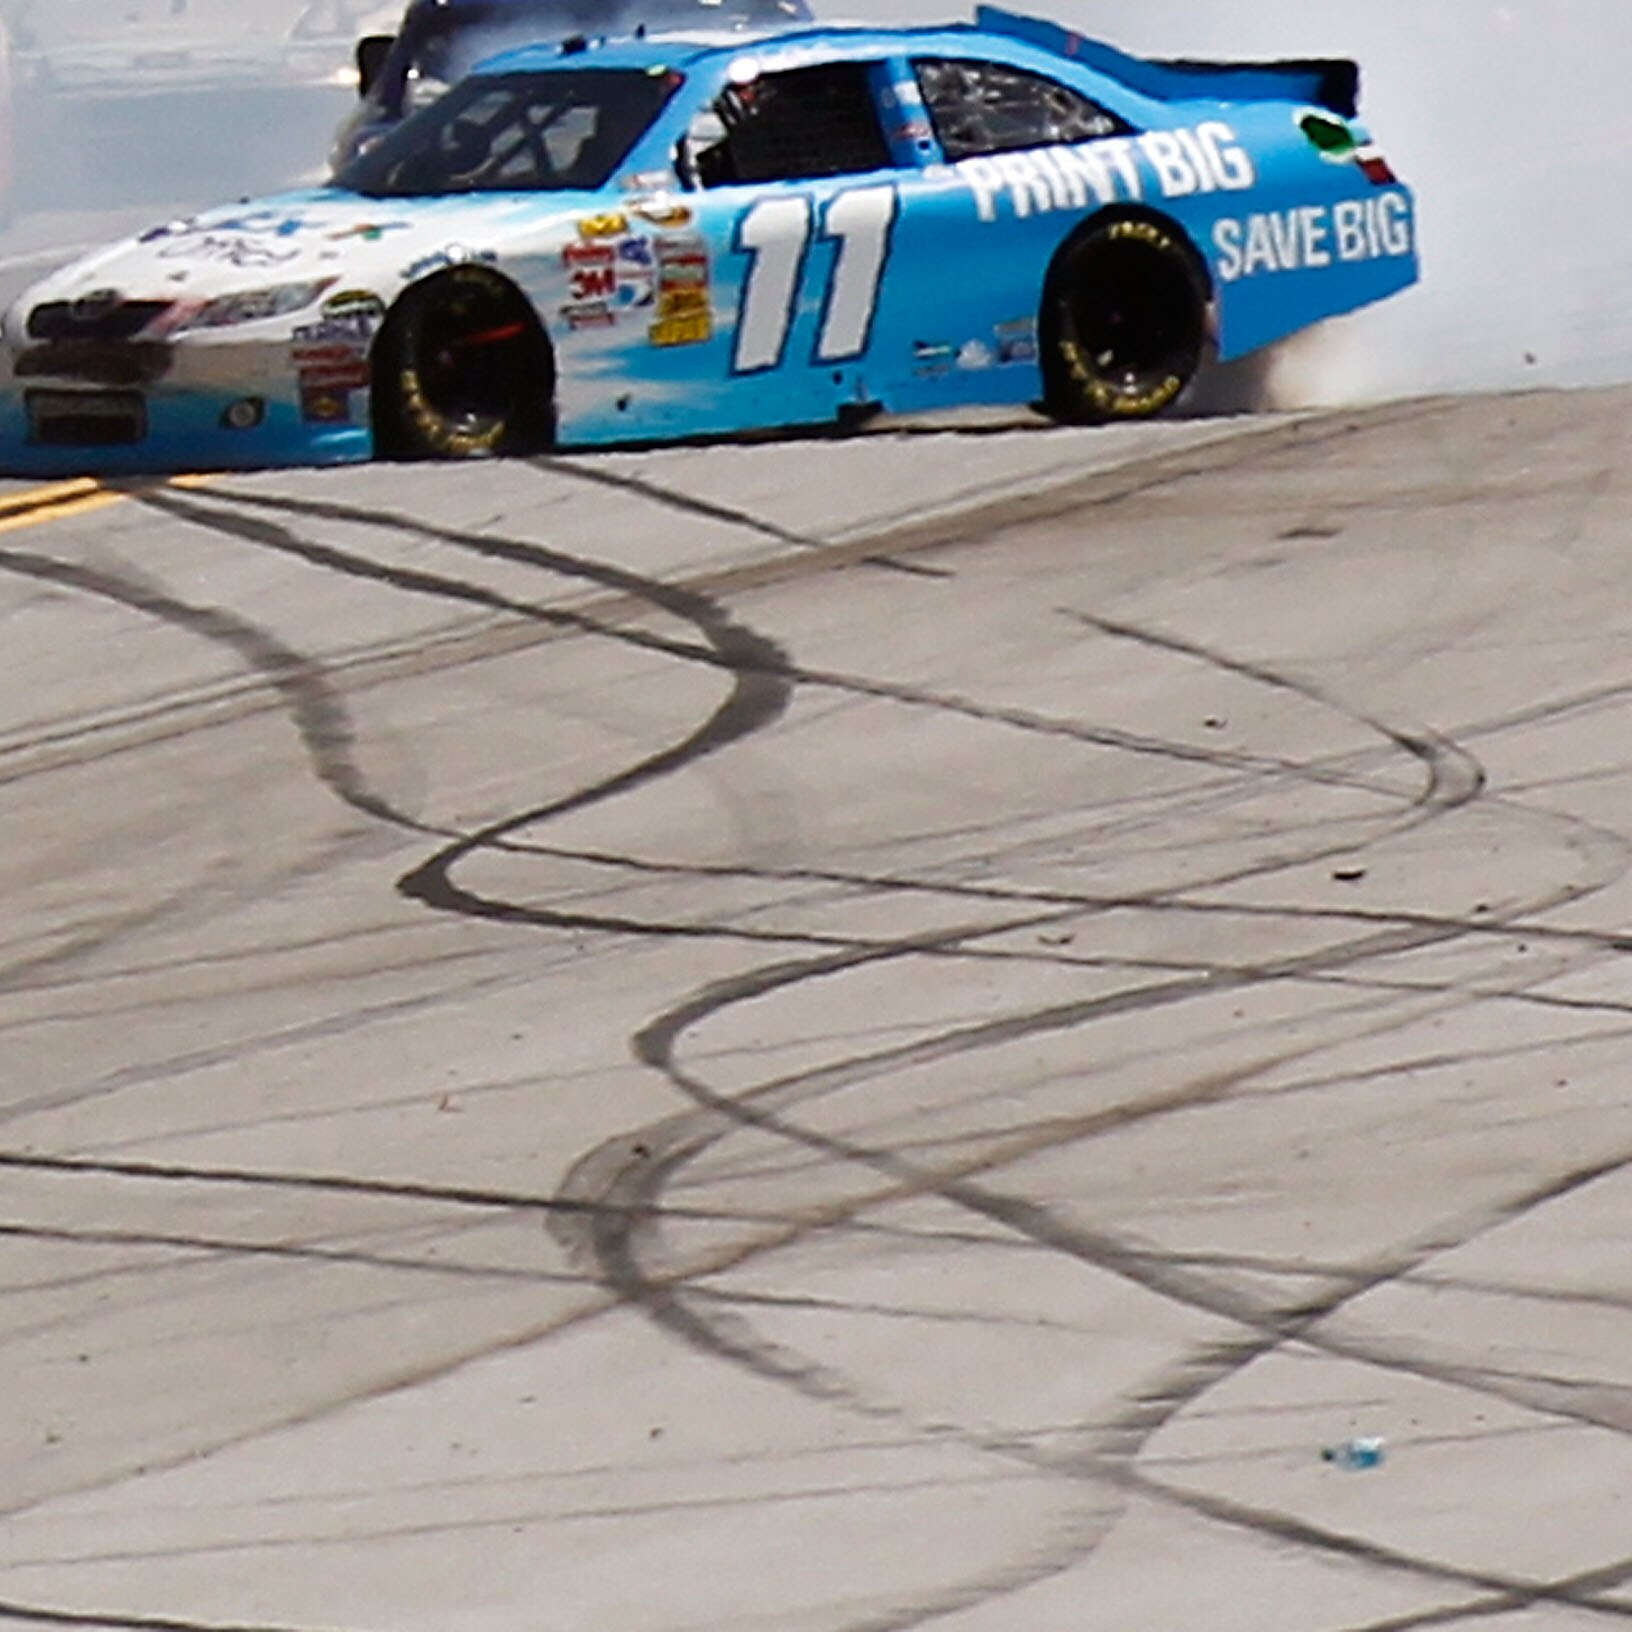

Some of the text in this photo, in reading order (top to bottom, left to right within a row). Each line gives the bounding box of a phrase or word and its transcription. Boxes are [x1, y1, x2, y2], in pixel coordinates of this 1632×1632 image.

[956, 121, 1255, 221] PRINT BIG
[733, 184, 896, 371] 11
[1213, 191, 1410, 281] SAVE BIG
